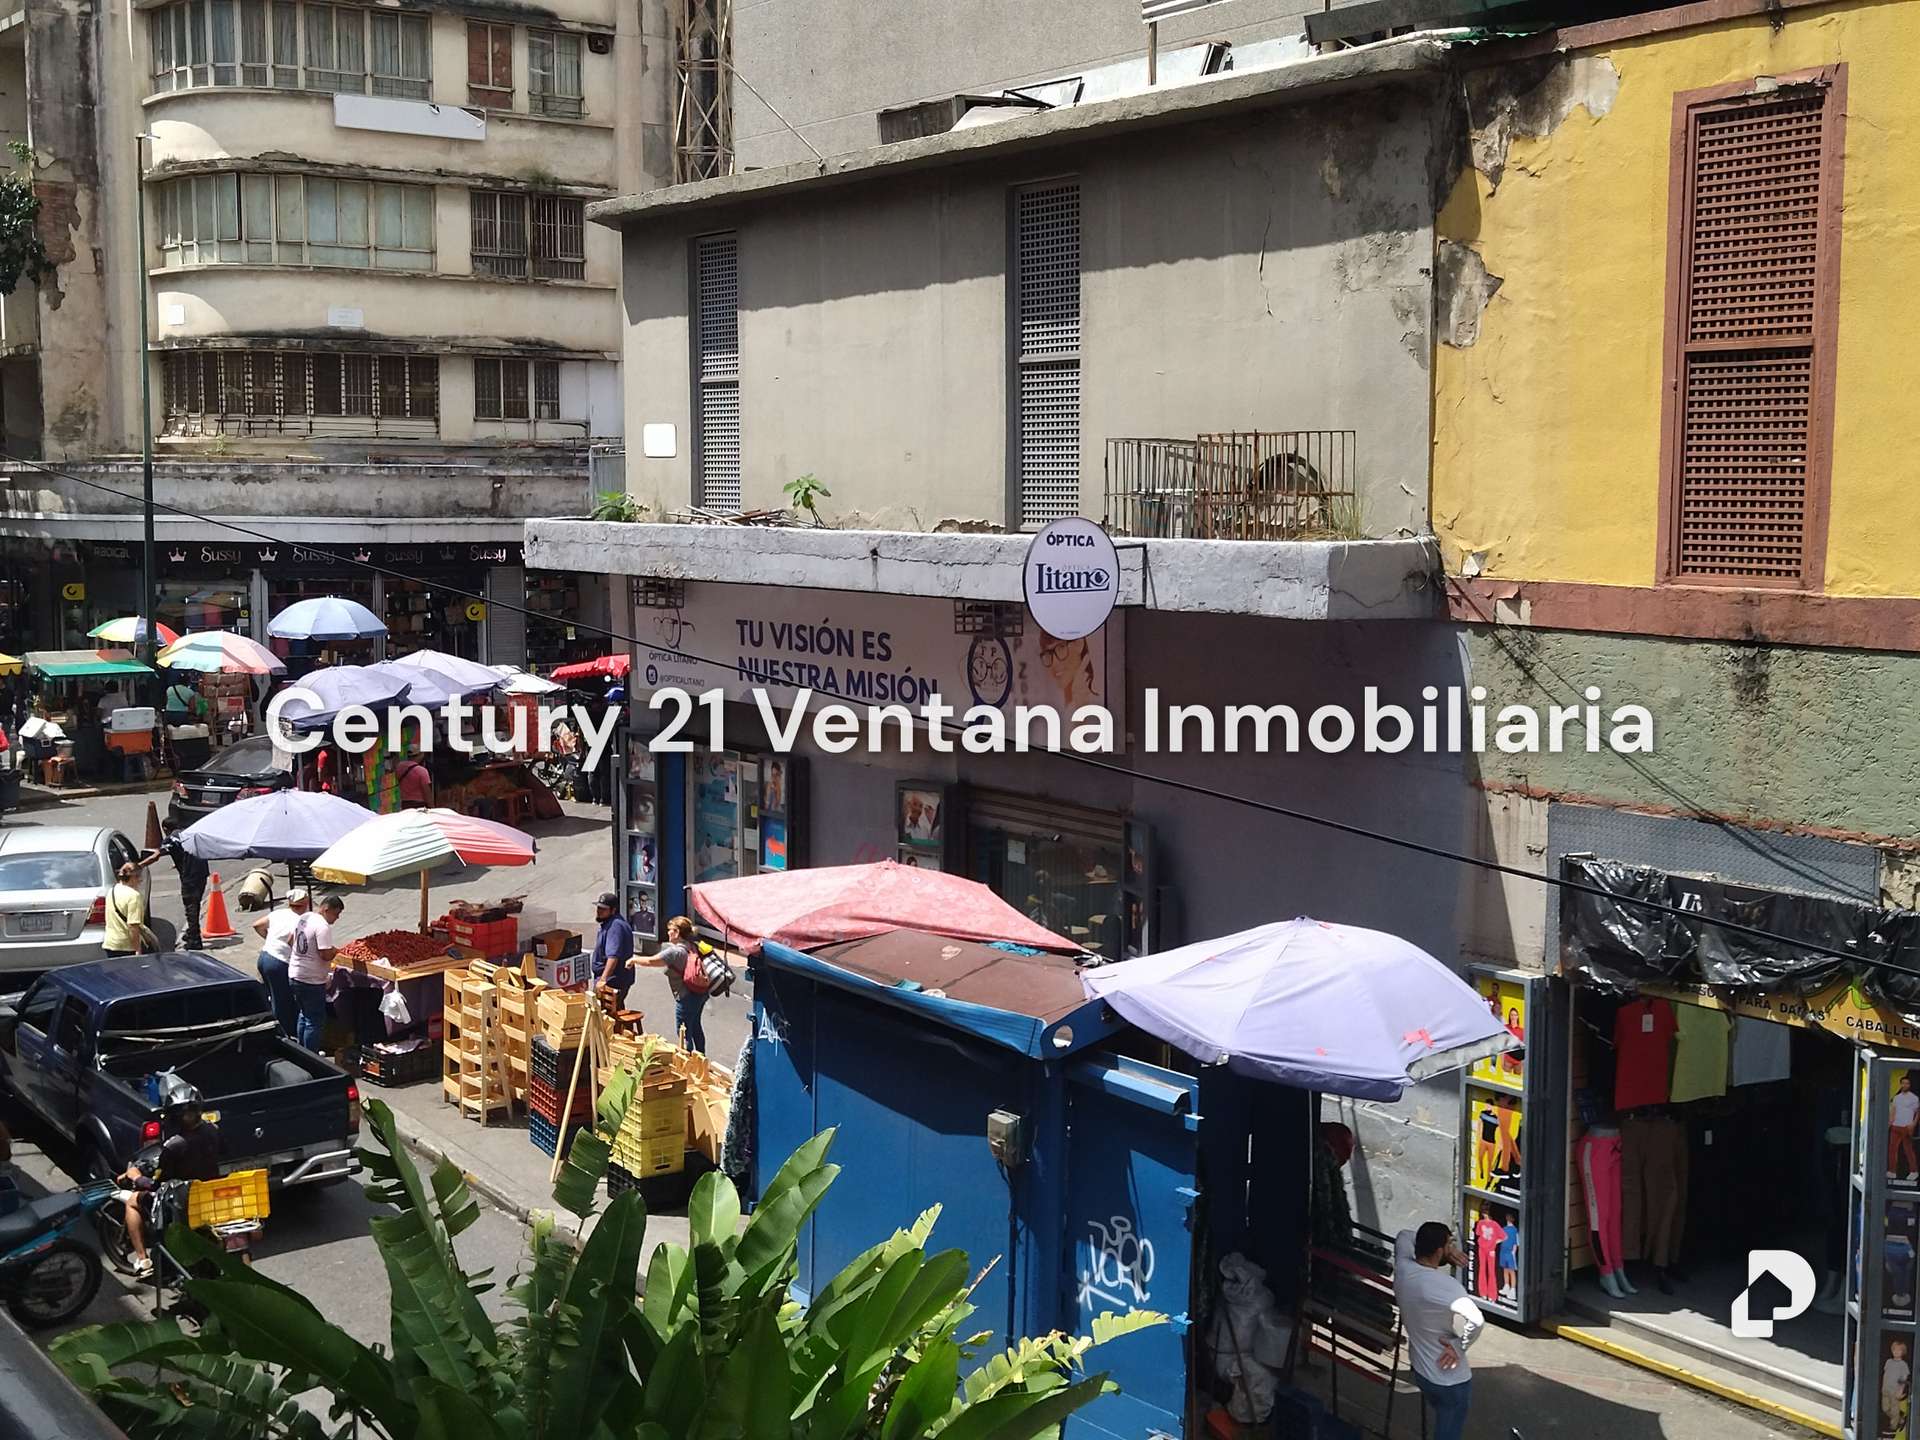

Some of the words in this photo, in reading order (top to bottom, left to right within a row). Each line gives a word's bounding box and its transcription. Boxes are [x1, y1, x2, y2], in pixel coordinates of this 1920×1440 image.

[1046, 531, 1095, 547] ÓPTICA
[200, 546, 241, 564] Sussy
[292, 547, 336, 565] Sussy
[469, 545, 507, 562] Sussy
[735, 618, 764, 648] TU
[769, 617, 854, 658] VISIÓN
[862, 631, 892, 662] ES
[738, 656, 840, 694] NUESTRA
[846, 666, 938, 706] MISIÓN
[1738, 995, 1772, 1010] PARA
